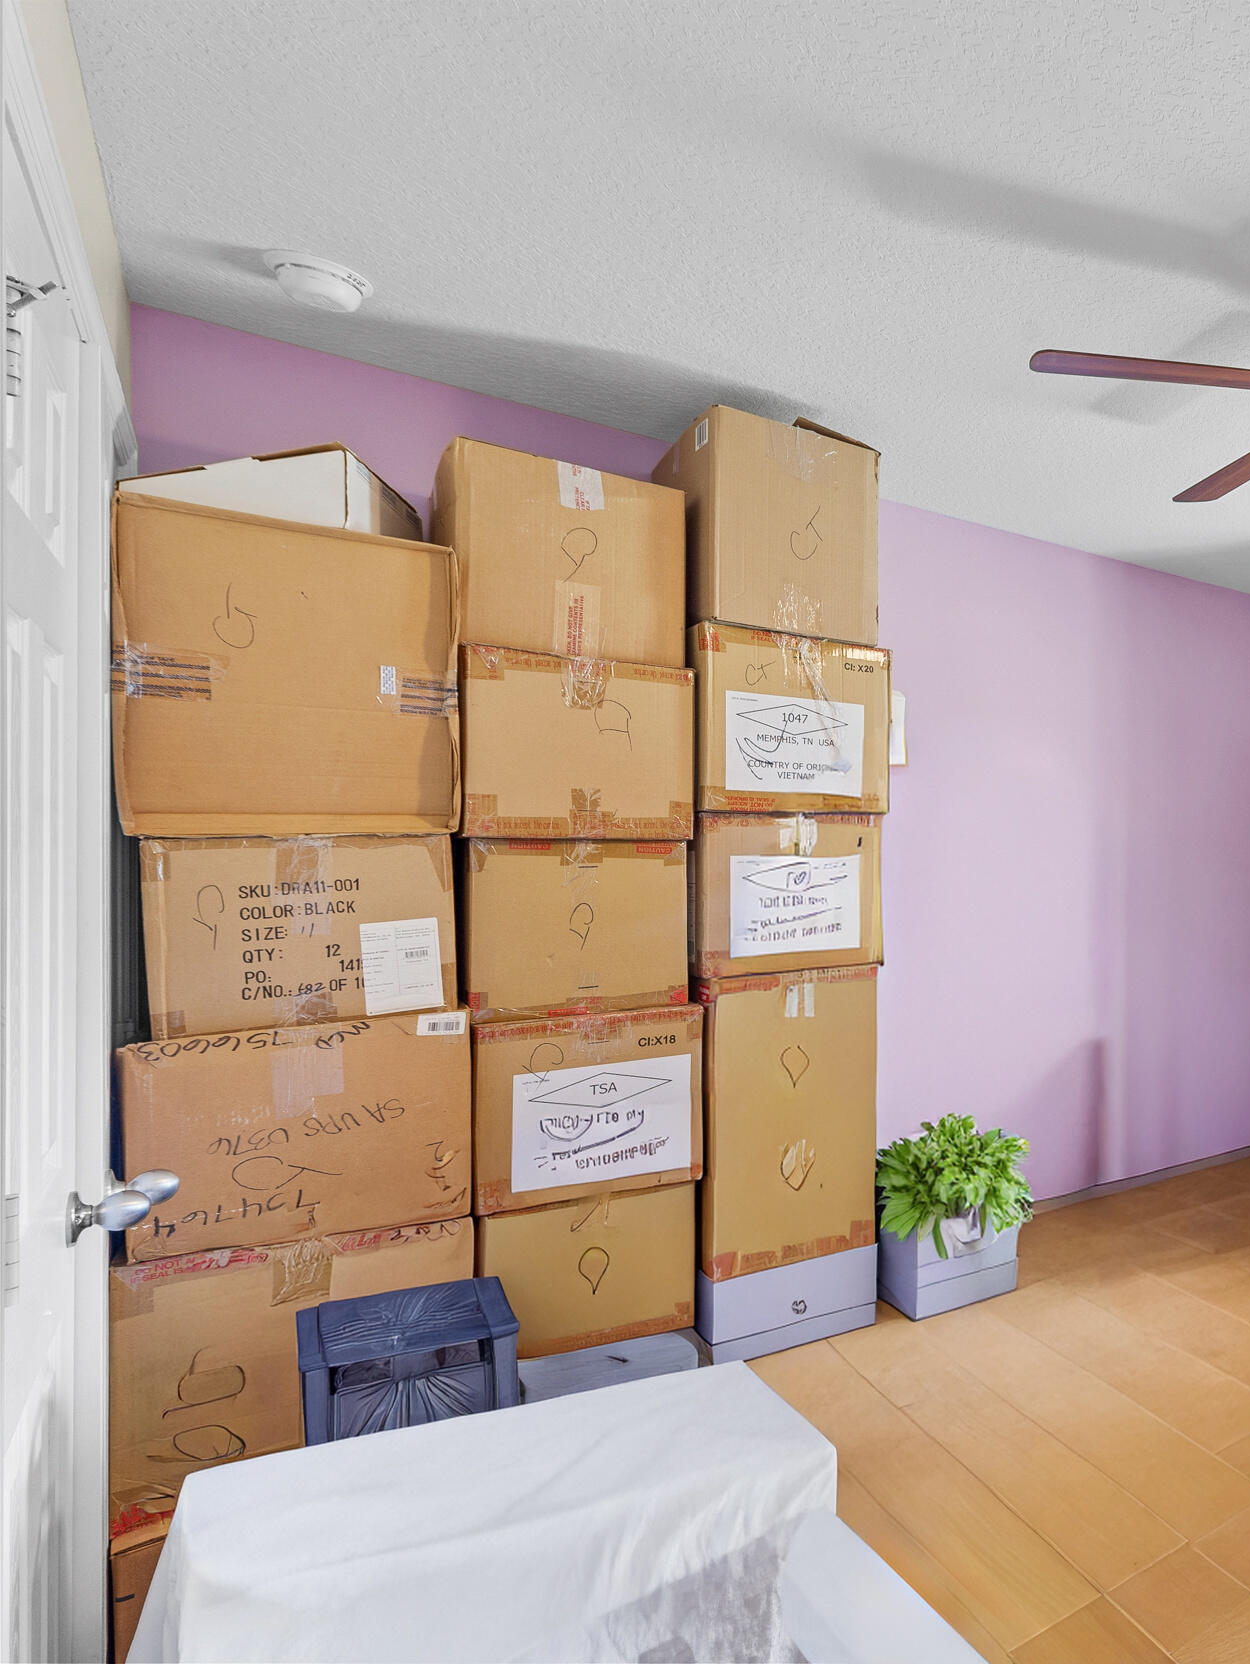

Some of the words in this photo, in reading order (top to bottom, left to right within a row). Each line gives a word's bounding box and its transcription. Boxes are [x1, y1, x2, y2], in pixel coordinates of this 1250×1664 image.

[858, 664, 874, 674] X20
[782, 712, 808, 724] 1047
[756, 734, 800, 745] MEMPHIS,
[802, 737, 814, 745] TN
[818, 739, 835, 747] USA
[748, 760, 789, 770] COUNTRY
[792, 762, 804, 770] OF
[777, 771, 815, 780] VIETNAM
[241, 926, 288, 942] SIZE:
[242, 948, 283, 964] QTY:
[325, 944, 341, 958] 12
[244, 970, 272, 984] PO:
[329, 978, 348, 991] OF
[638, 1034, 676, 1048] CI:X18
[590, 1082, 618, 1095] TSA
[154, 1258, 181, 1272] NOT
[143, 1272, 172, 1282] SEAL
